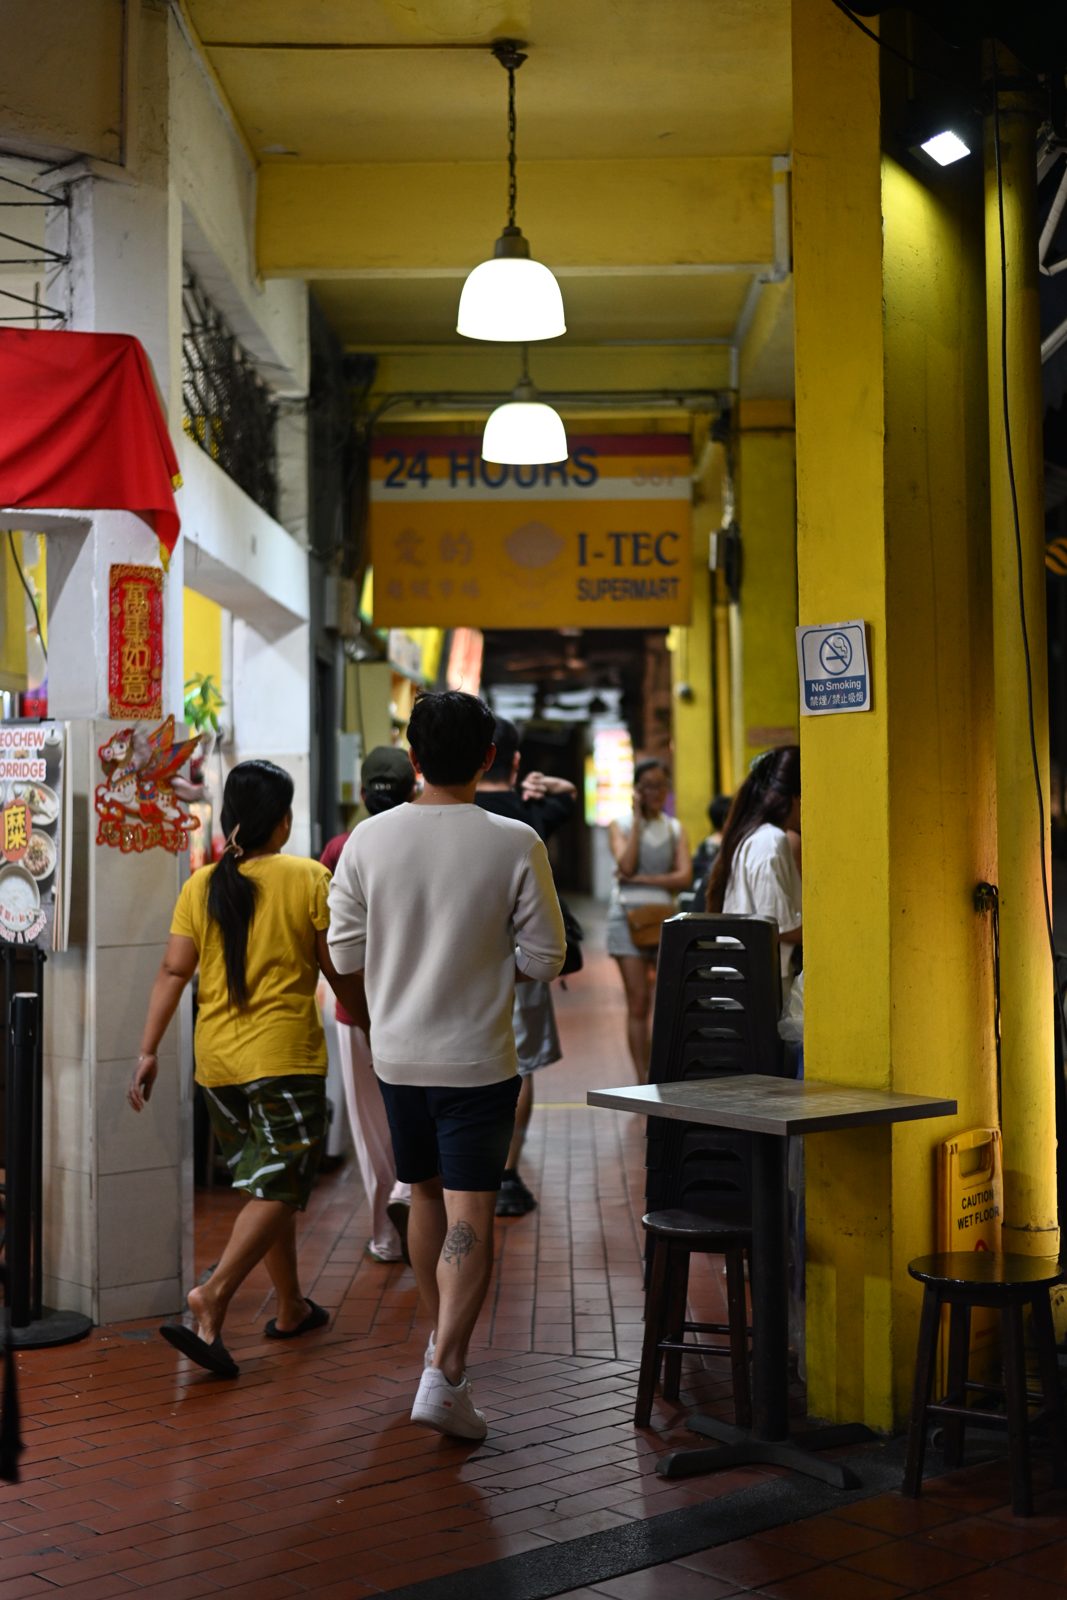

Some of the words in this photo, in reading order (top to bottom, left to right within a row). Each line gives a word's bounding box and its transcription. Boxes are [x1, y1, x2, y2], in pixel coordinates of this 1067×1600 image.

[384, 449, 431, 488] 24
[450, 447, 598, 489] HOURS
[578, 532, 678, 567] I-TEC
[577, 578, 679, 601] SUPERMART
[811, 682, 824, 692] No
[826, 679, 861, 691] Smoking
[0, 731, 44, 747] EOCHEW
[0, 762, 44, 778] ORRIDGE
[961, 1190, 994, 1209] CAUTION
[957, 1215, 973, 1230] WET
[975, 1206, 1000, 1224] FLOOR
